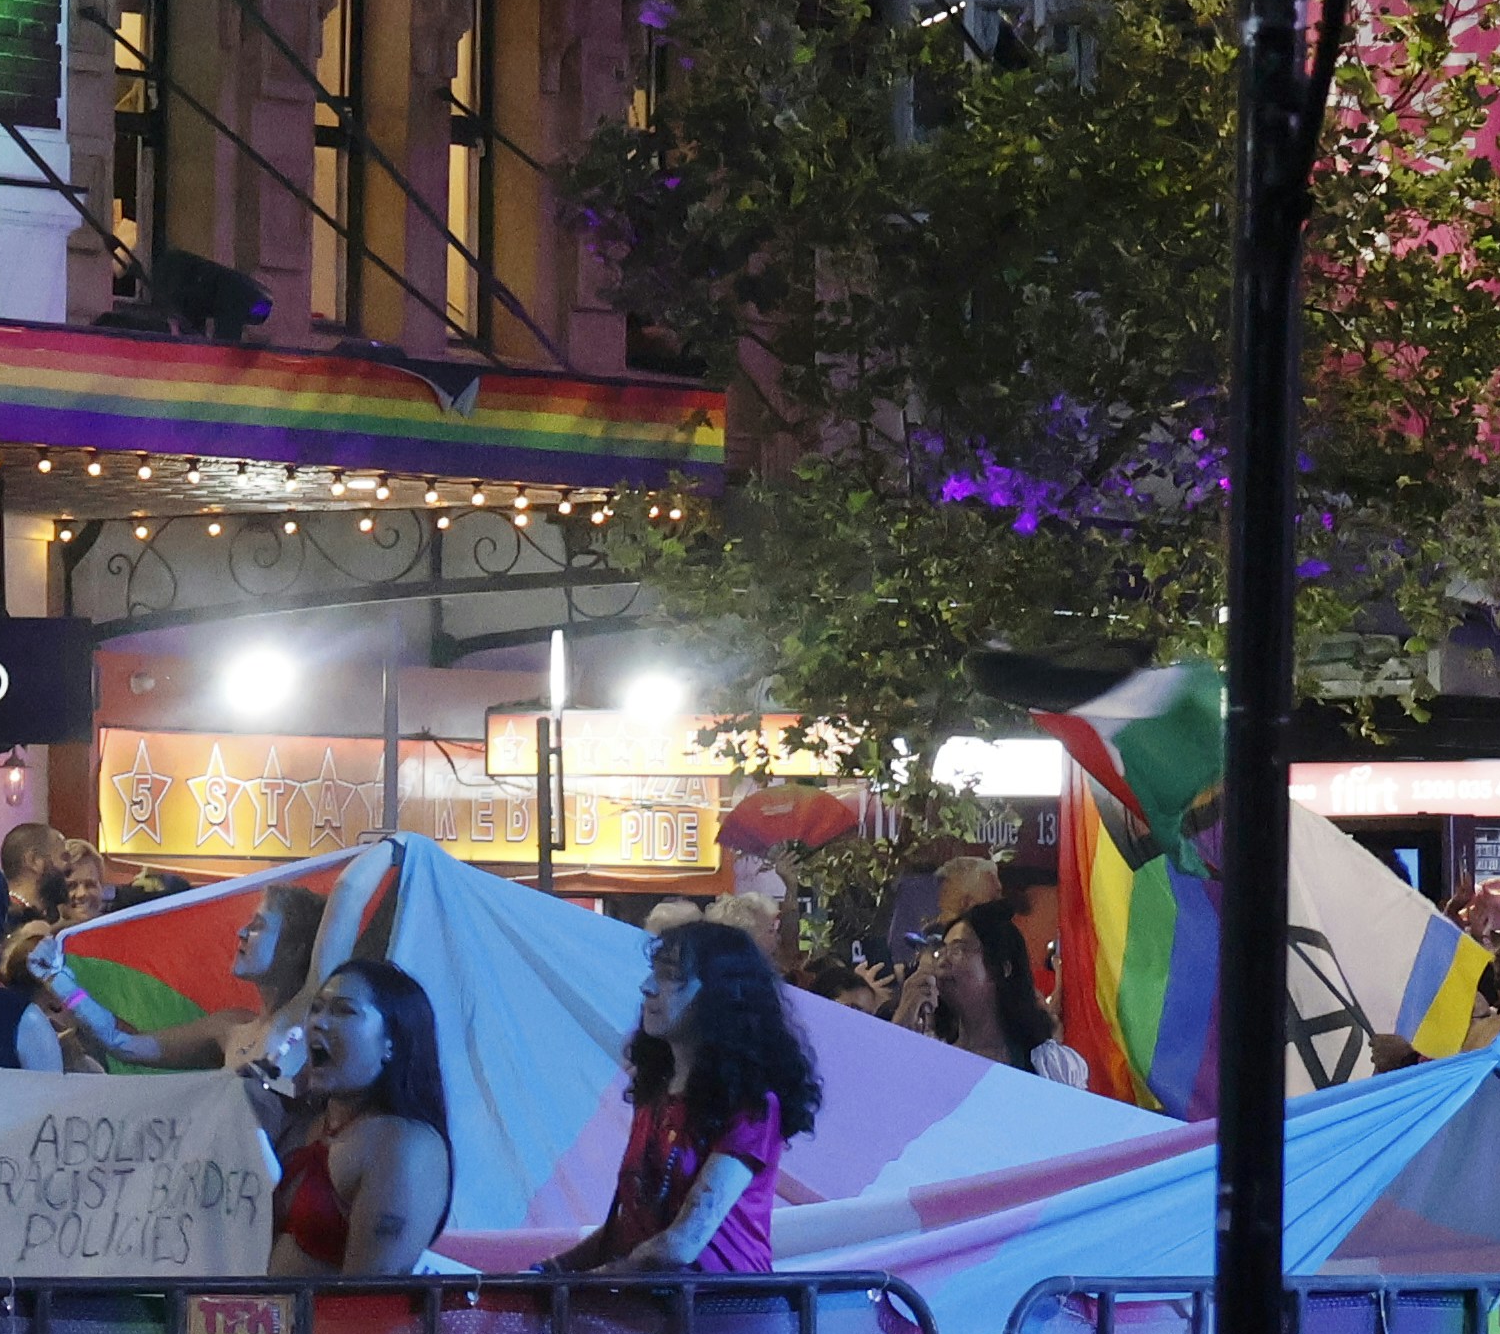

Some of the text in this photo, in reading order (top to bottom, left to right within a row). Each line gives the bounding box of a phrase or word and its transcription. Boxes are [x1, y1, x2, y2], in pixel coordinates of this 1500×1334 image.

[433, 772, 599, 845] KEBB
[1329, 764, 1399, 813] flirt
[620, 810, 699, 861] PIDE
